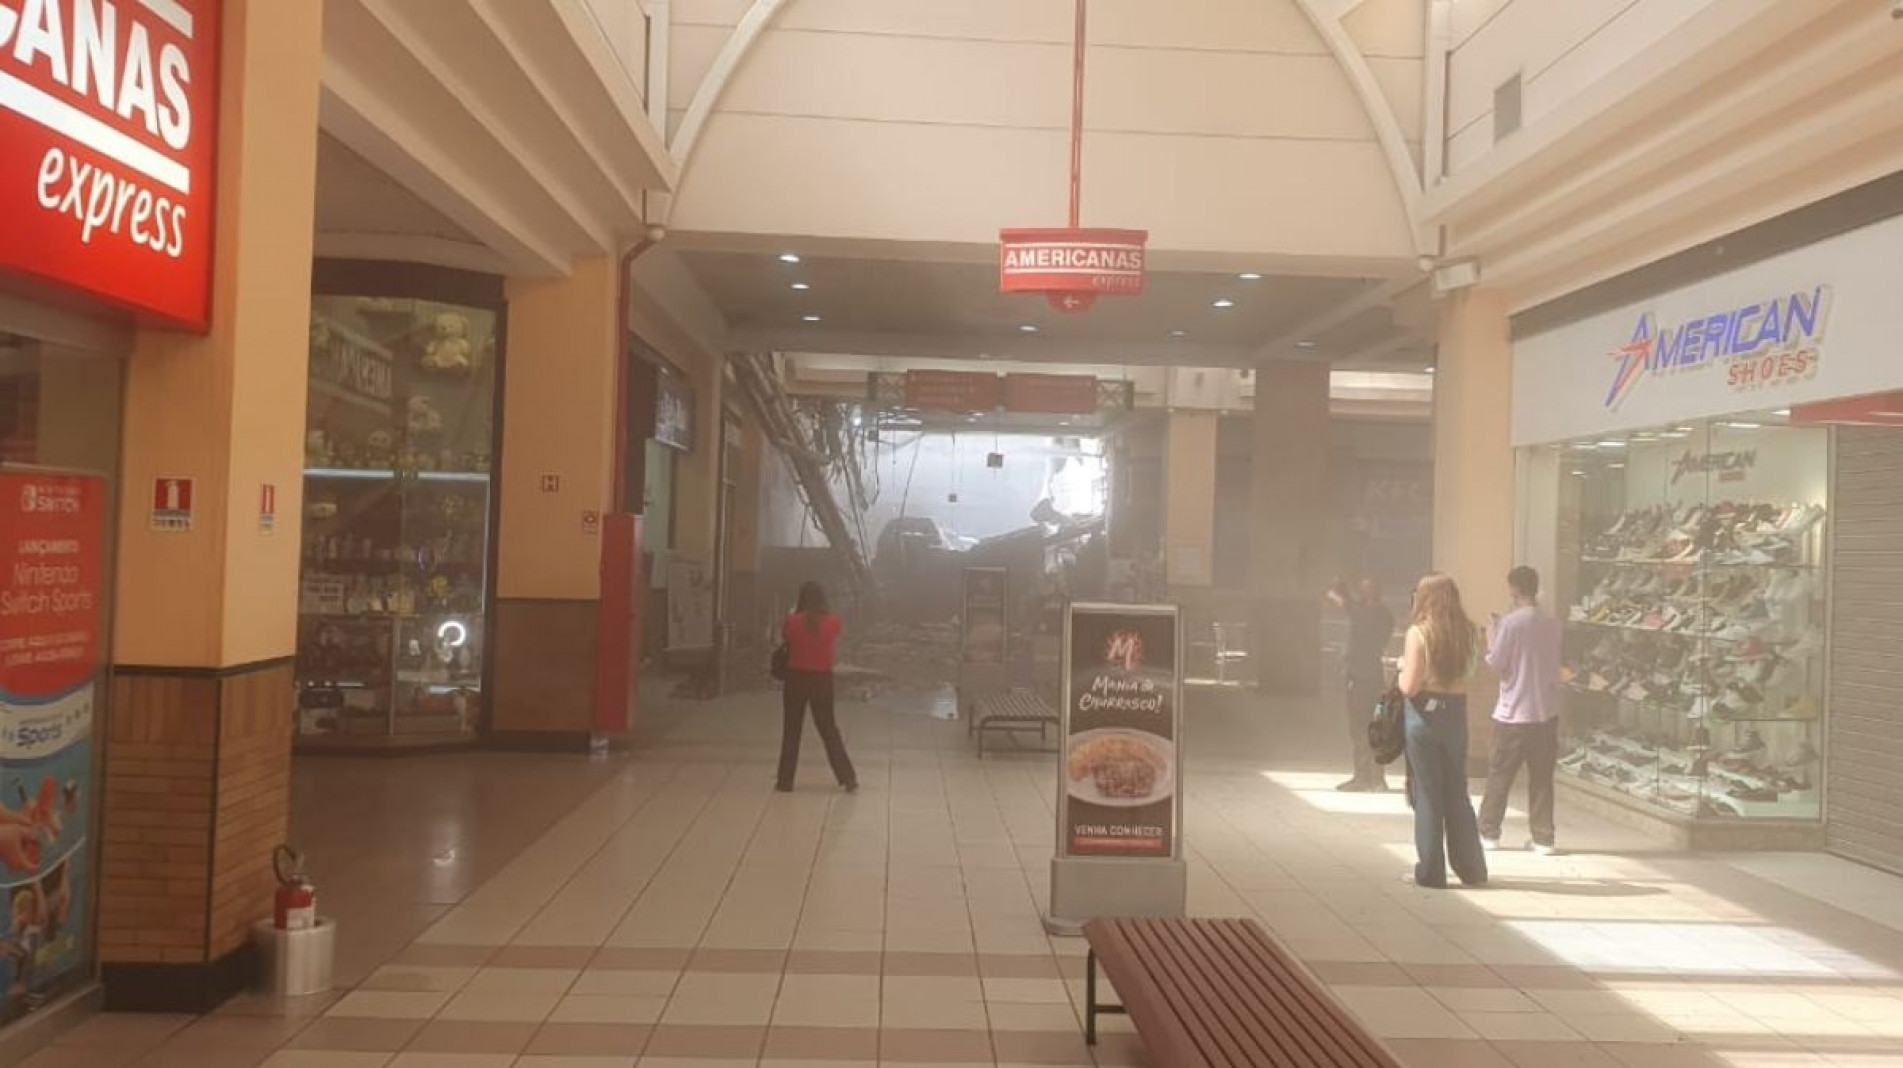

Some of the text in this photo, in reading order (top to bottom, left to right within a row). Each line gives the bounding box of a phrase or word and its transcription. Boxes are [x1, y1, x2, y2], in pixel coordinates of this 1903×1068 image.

[37, 147, 187, 258] express
[1004, 249, 1142, 269] AMERICANAS
[1605, 283, 1821, 408] AMERICAN
[1727, 350, 1808, 386] SHOES
